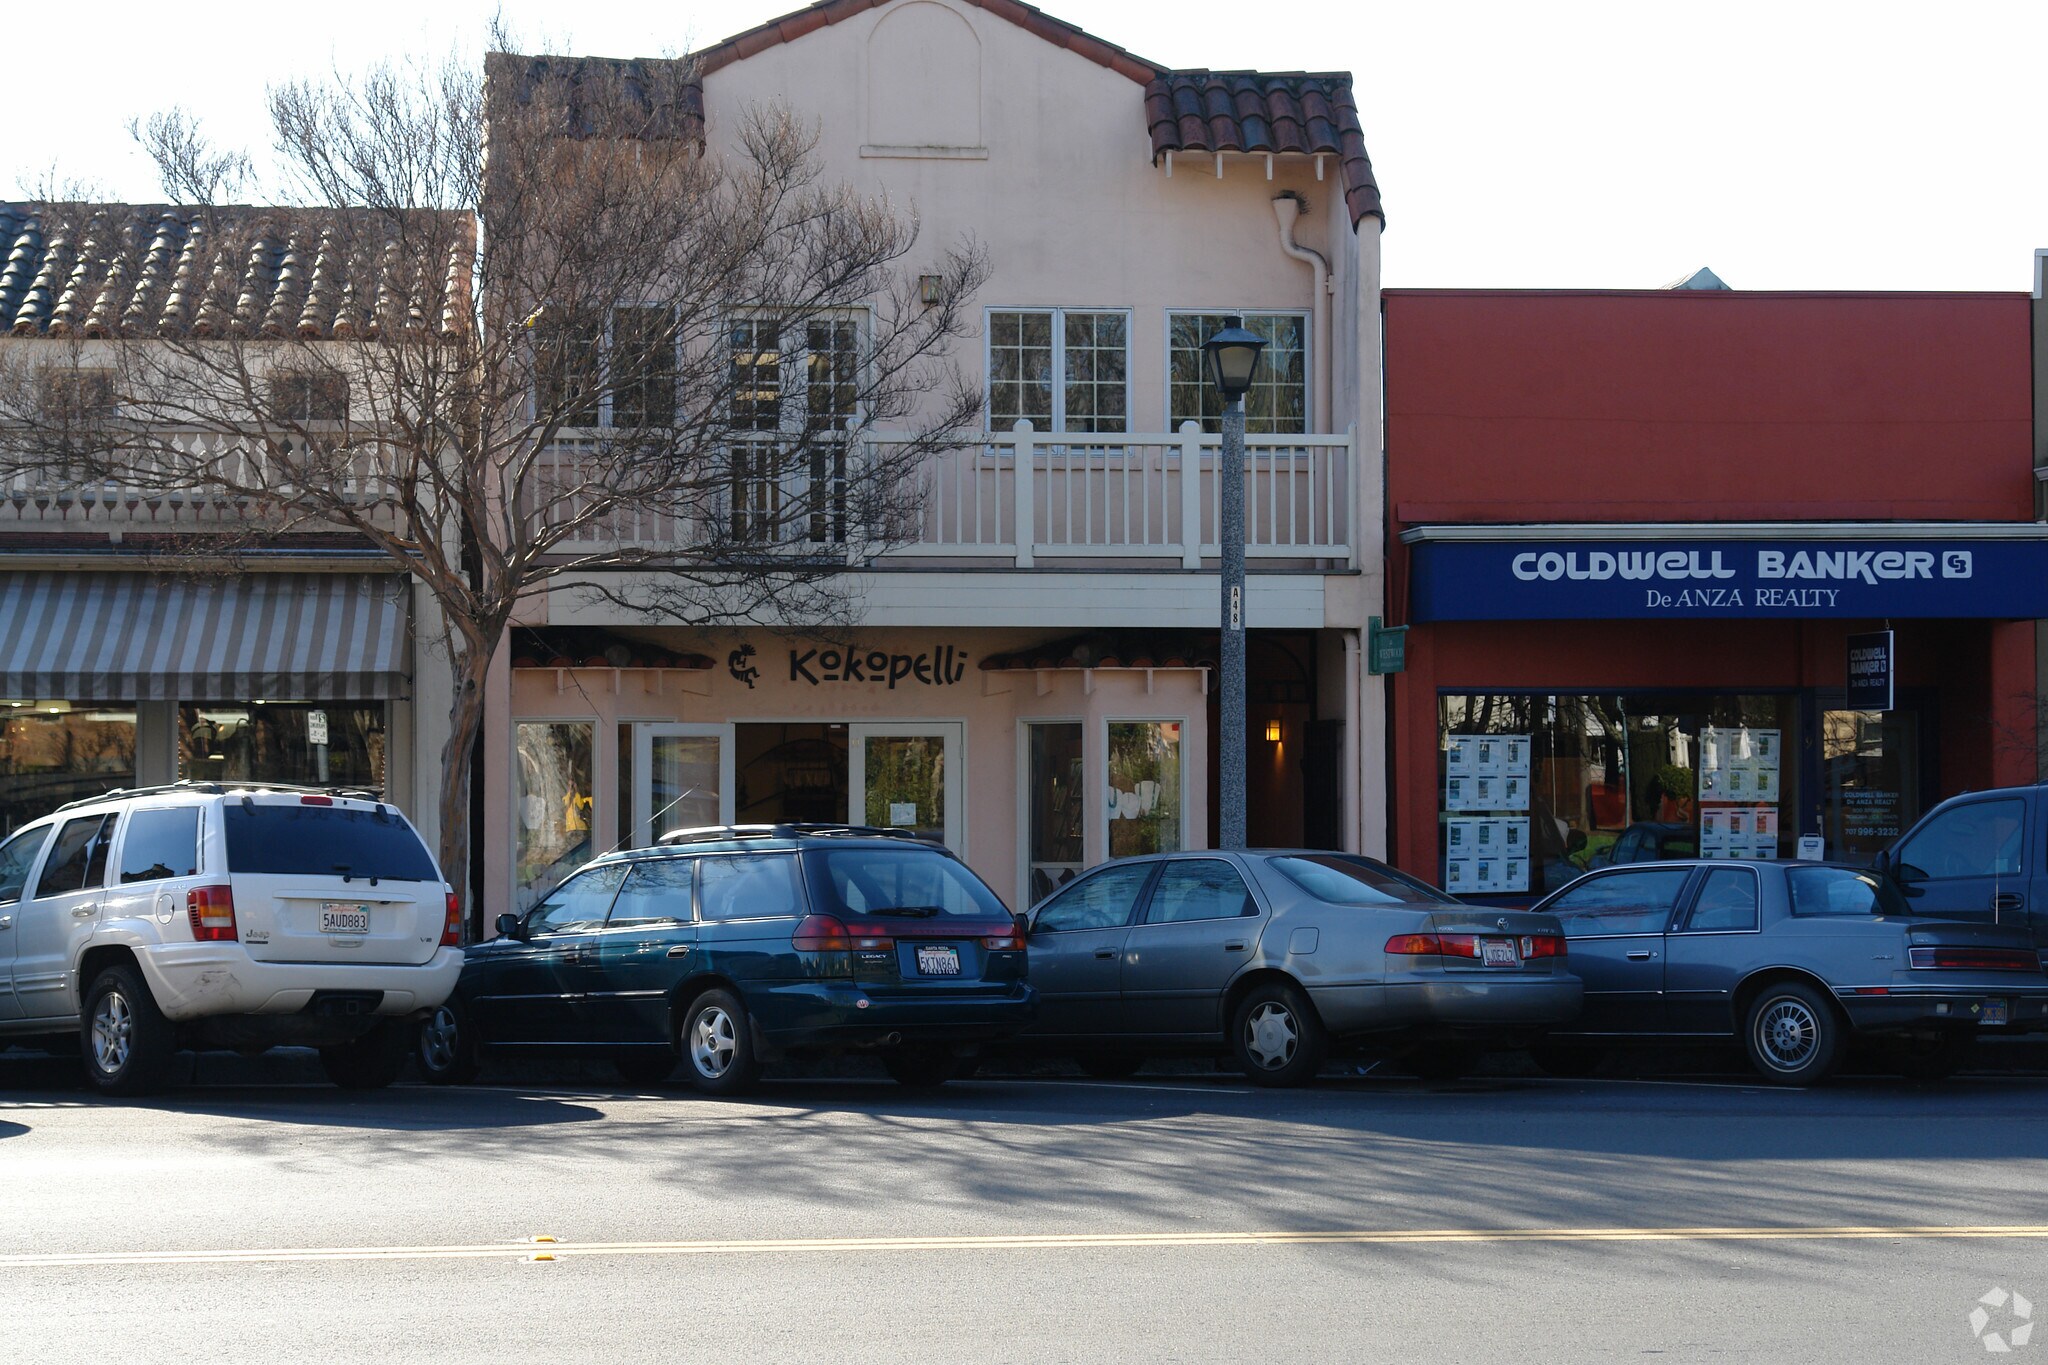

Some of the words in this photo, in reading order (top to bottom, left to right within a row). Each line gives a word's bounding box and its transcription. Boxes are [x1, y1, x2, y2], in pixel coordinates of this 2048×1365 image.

[1512, 551, 1736, 581] COLDWELL
[1758, 551, 1935, 585] BANKER
[1646, 590, 1671, 607] De
[1675, 589, 1744, 607] ANZA
[1755, 589, 1840, 607] REALTY
[1857, 827, 1899, 836] 996-3232
[323, 913, 366, 928] 5AUD883
[246, 929, 270, 940] Jeep
